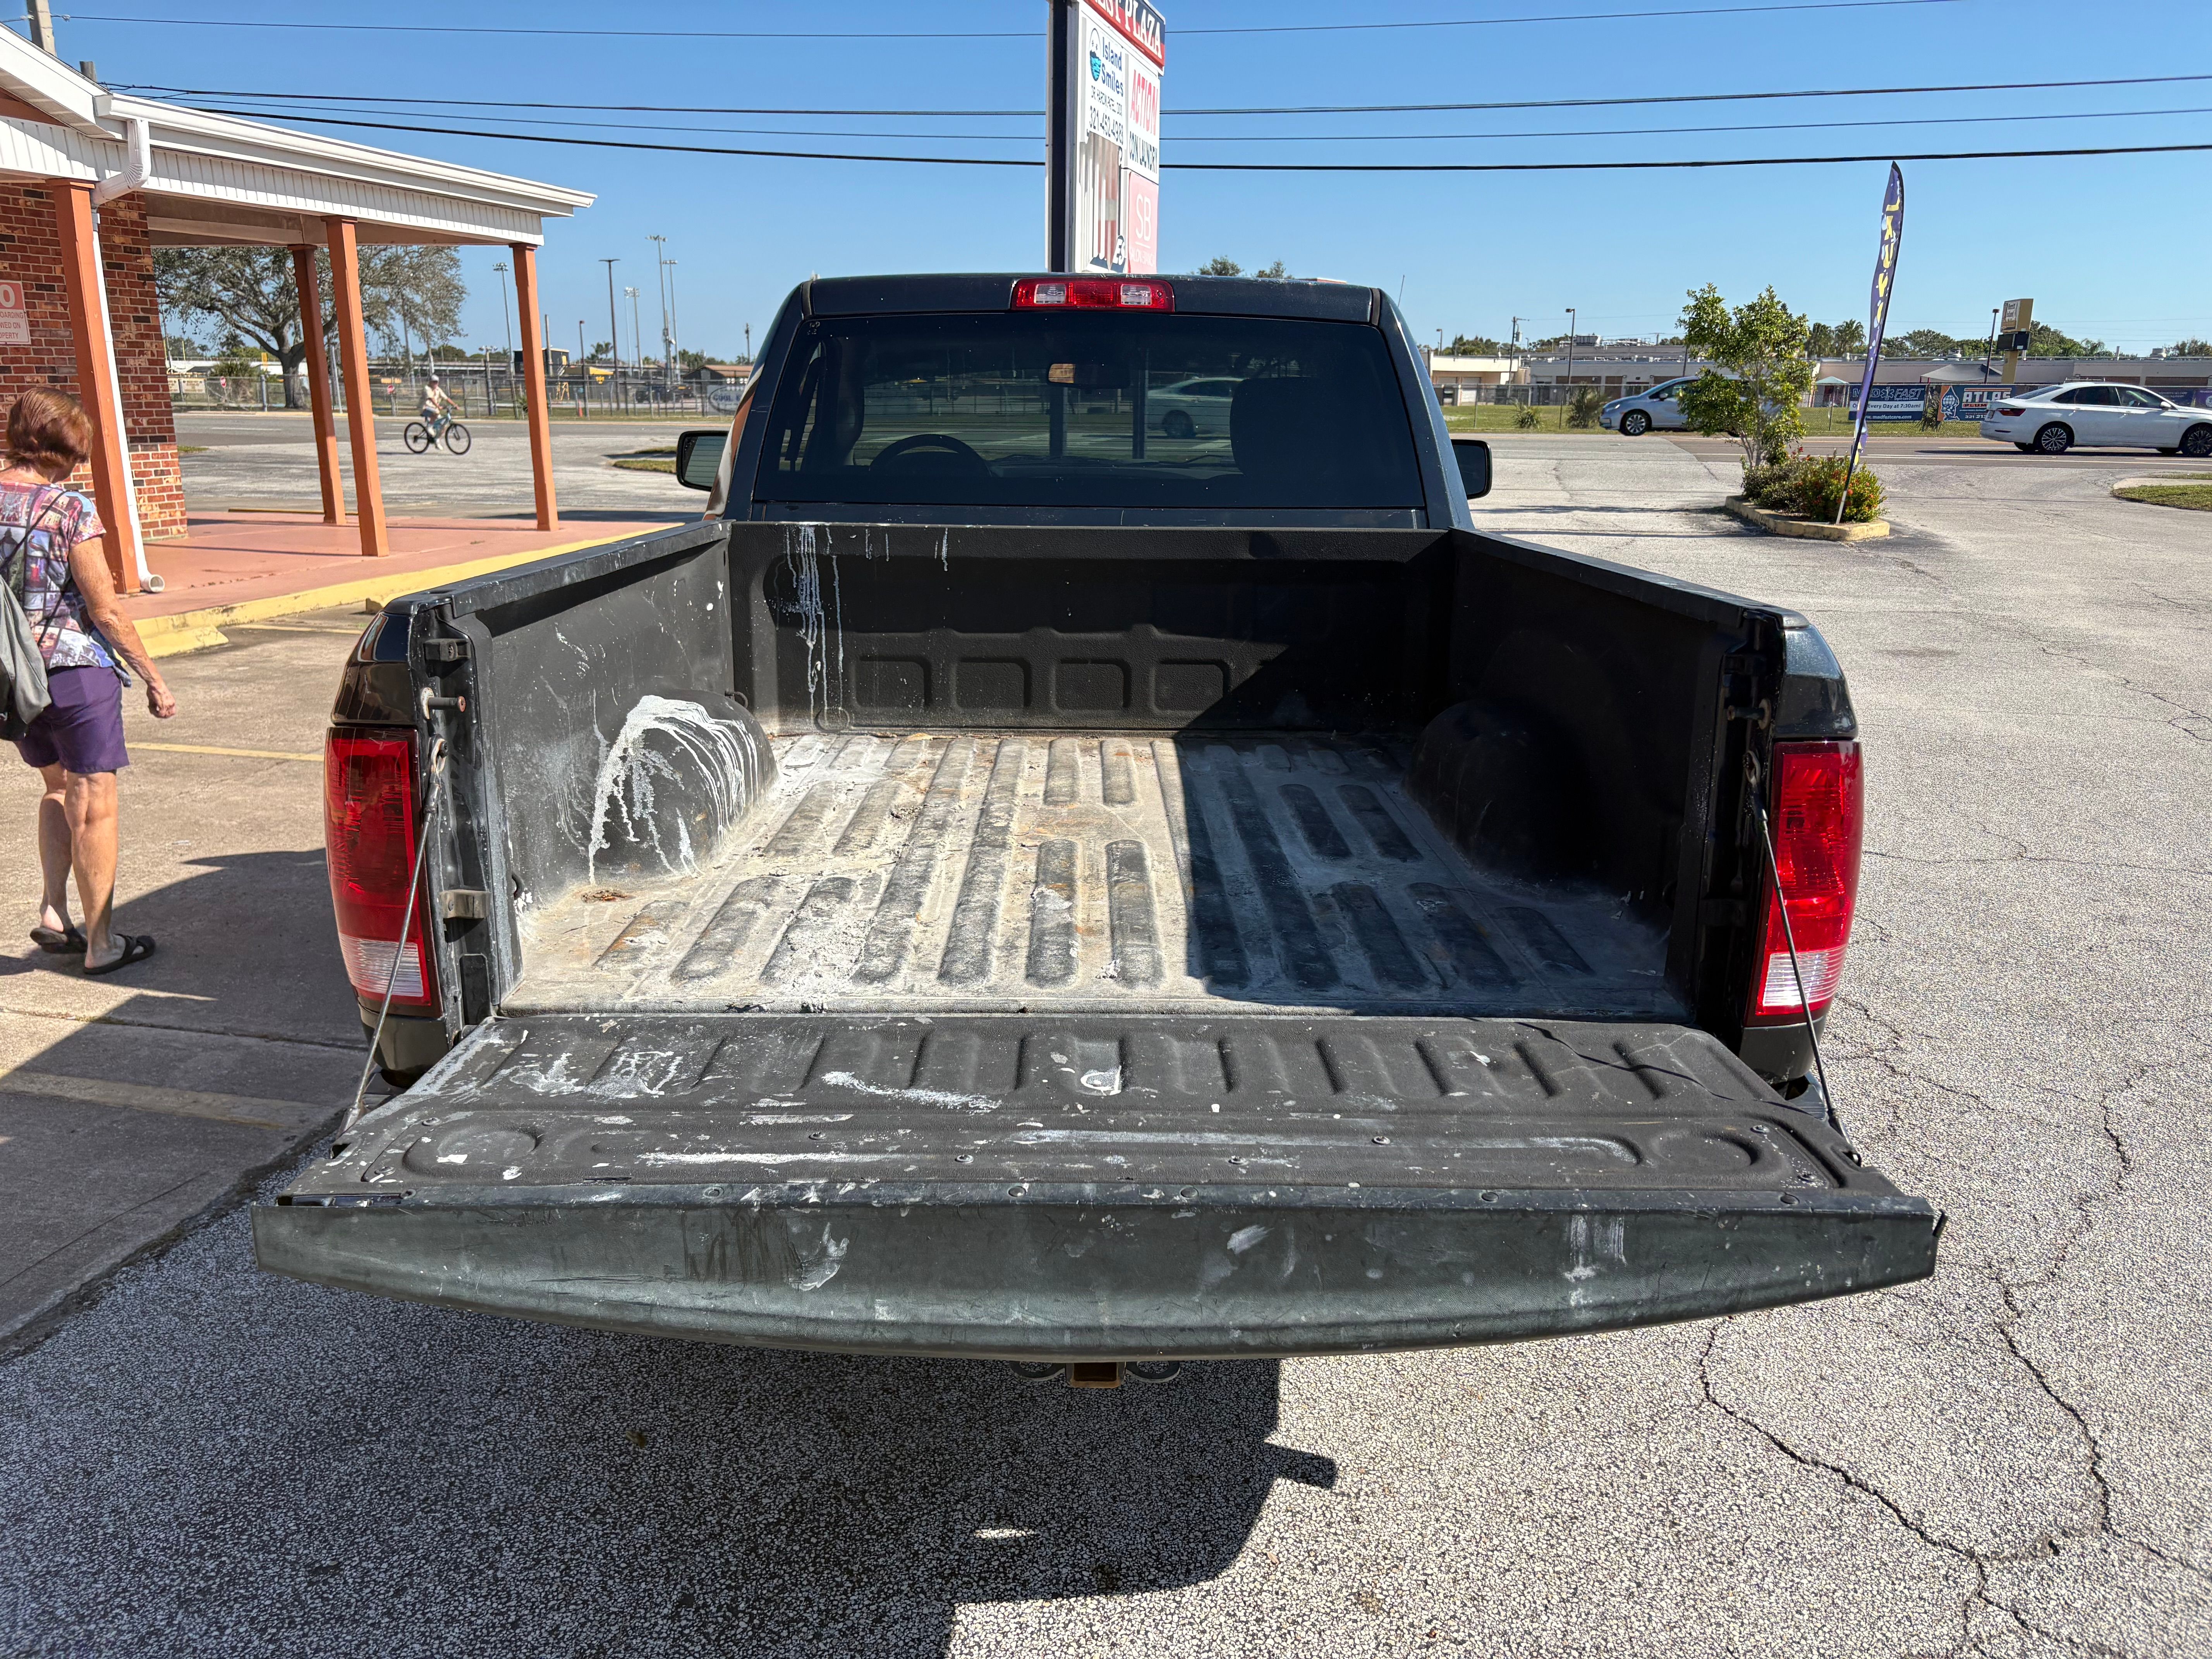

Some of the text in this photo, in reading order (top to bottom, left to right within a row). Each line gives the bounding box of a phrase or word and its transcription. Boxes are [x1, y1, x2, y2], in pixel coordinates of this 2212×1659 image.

[1125, 0, 1162, 59] PLAZA
[1103, 36, 1122, 72] Island
[1101, 63, 1123, 97] Smiles
[1130, 69, 1158, 136] ACTION
[1139, 137, 1158, 174] LAUNDRY
[1135, 193, 1151, 242] SB
[1894, 388, 1924, 398] FAST
[1963, 392, 2011, 402] ATLAS
